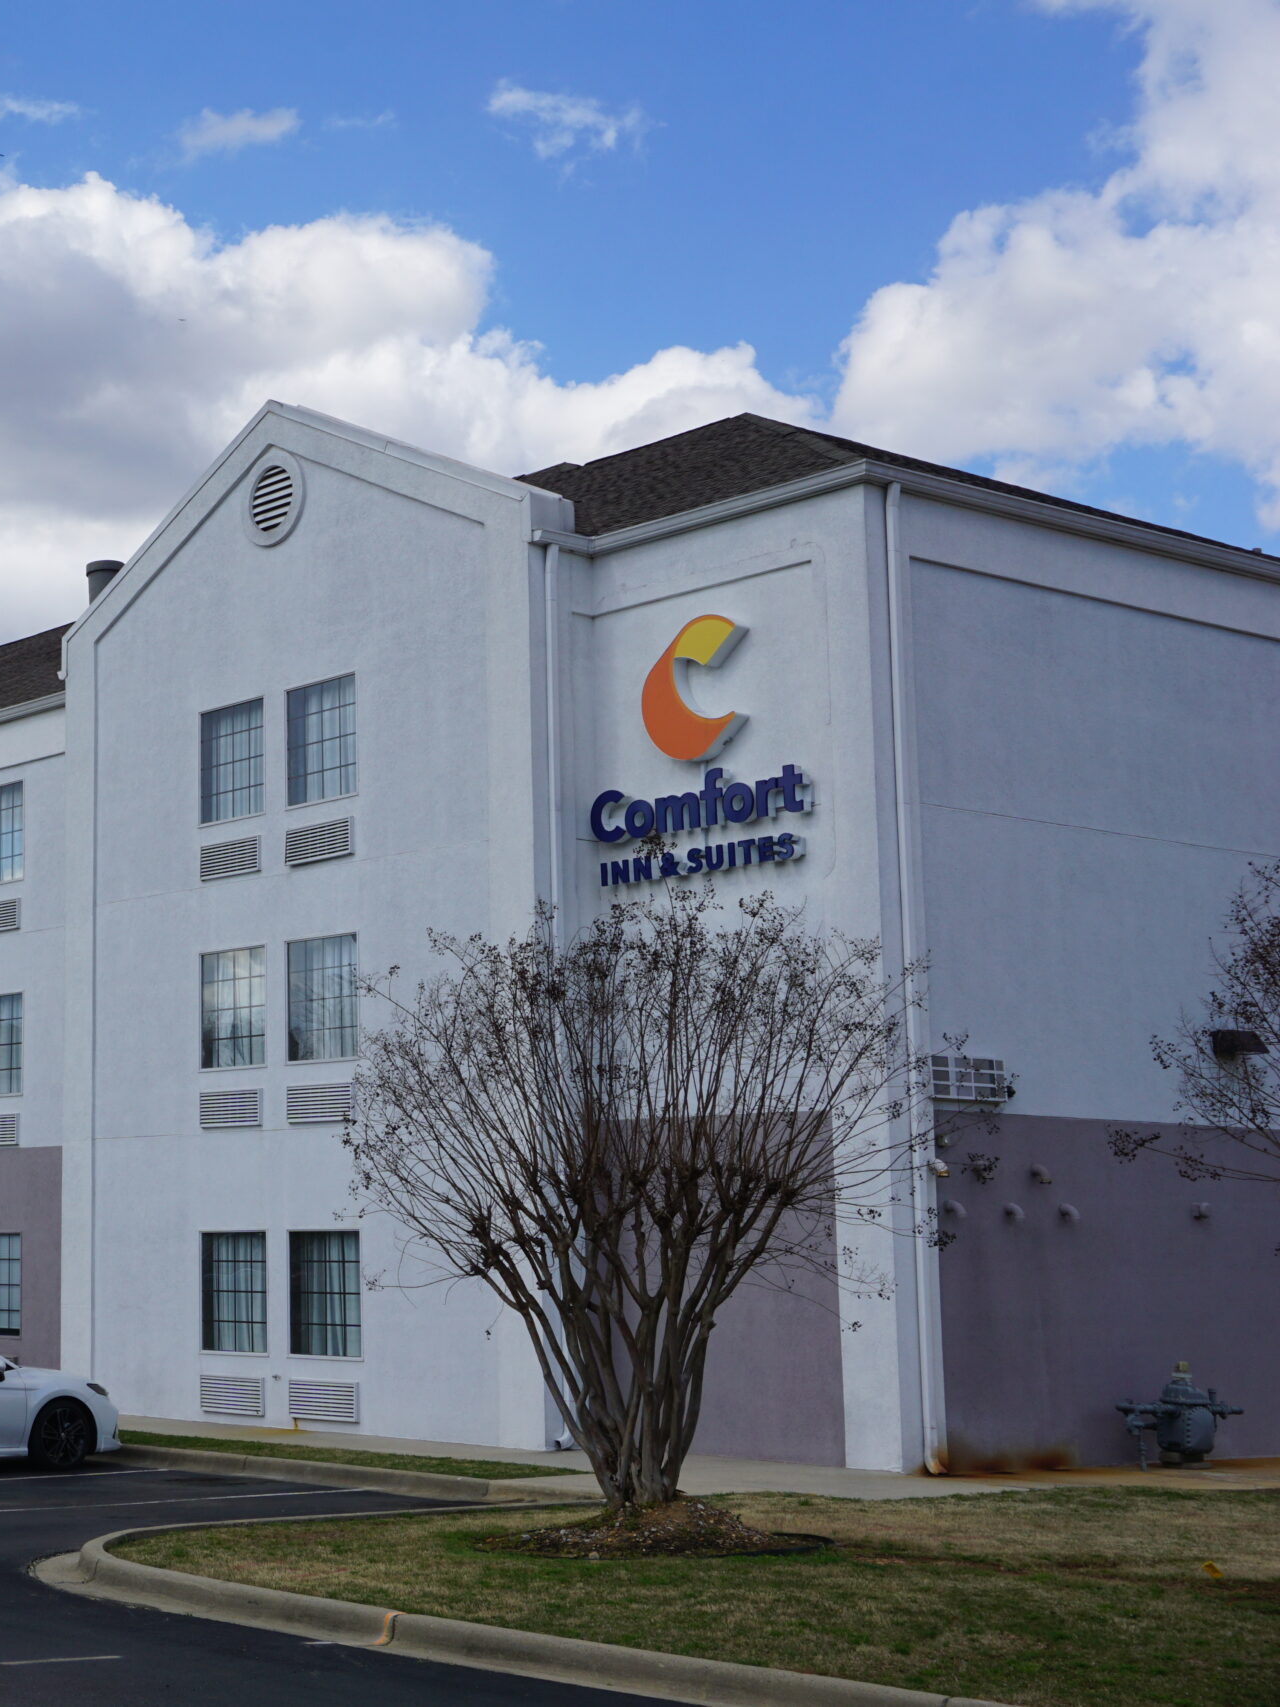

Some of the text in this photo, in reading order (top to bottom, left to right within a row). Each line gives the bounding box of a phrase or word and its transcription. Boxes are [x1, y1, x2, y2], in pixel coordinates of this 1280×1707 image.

[590, 764, 805, 844] Comfort
[600, 832, 796, 887] INN & SUITES
